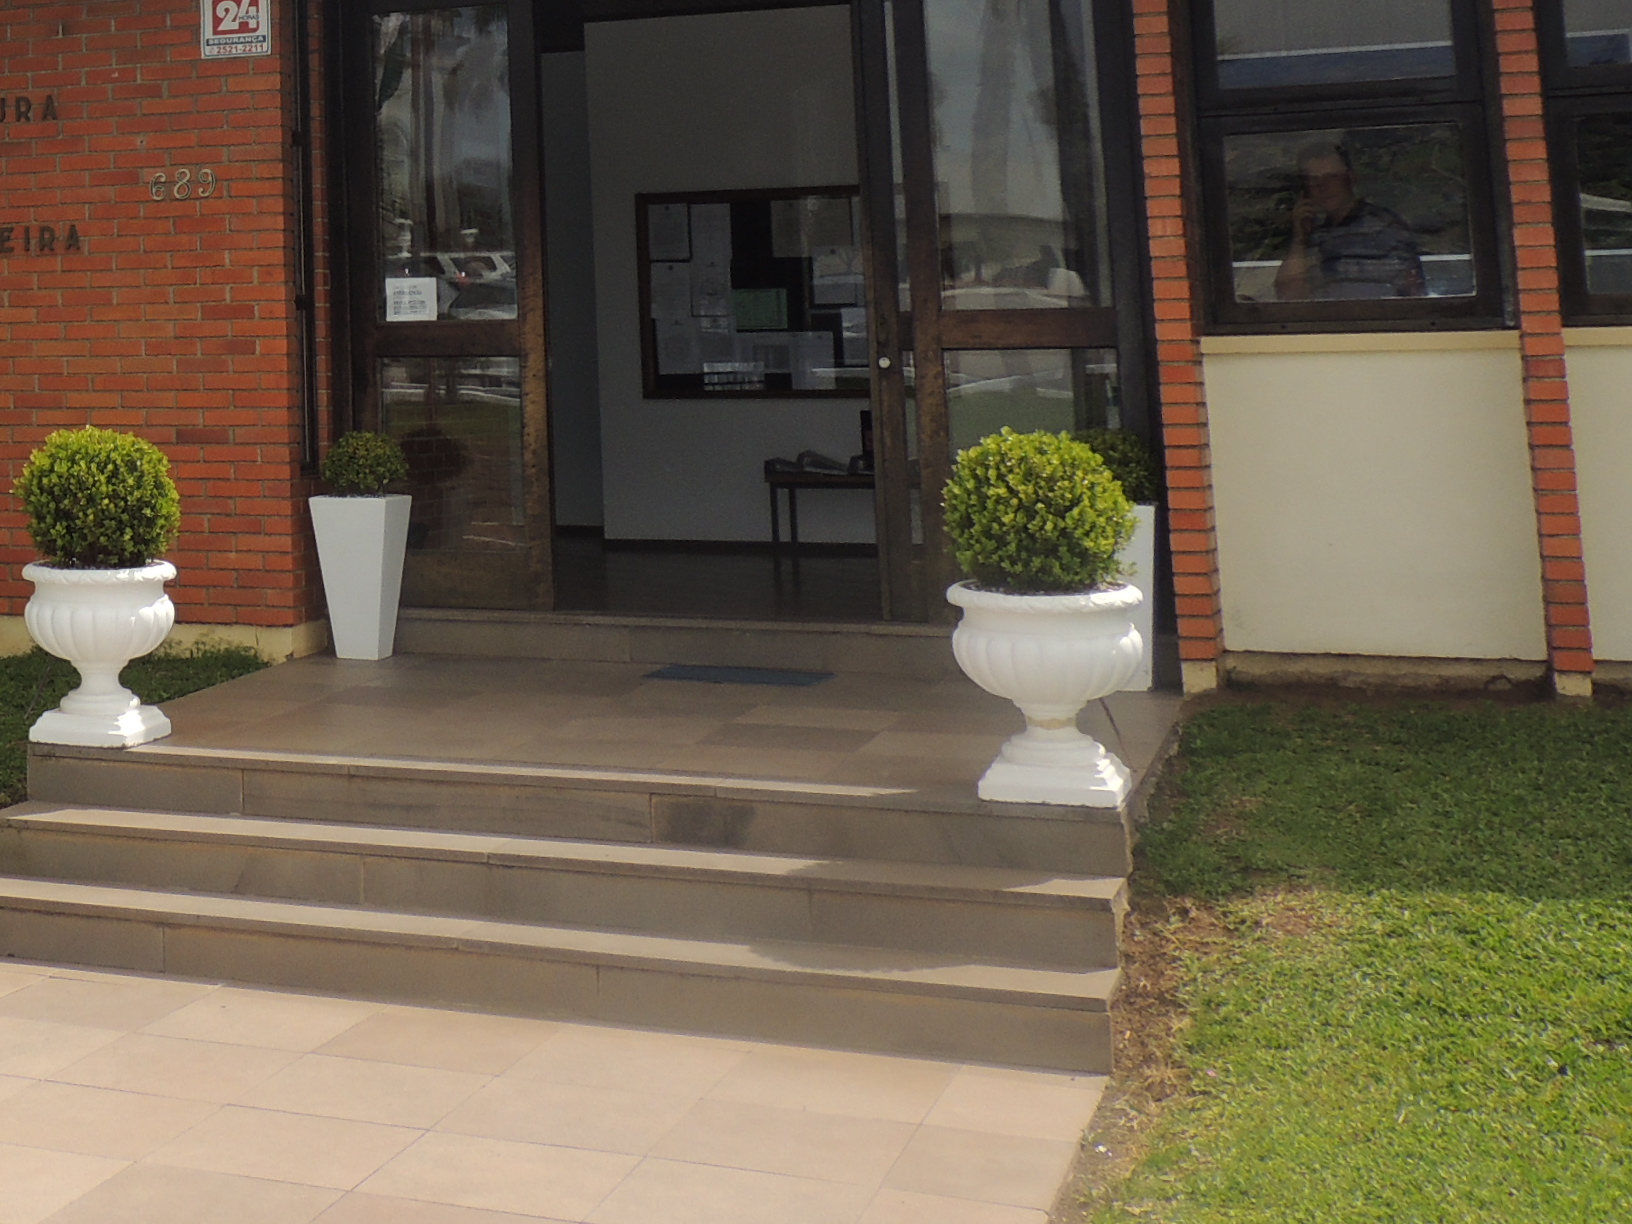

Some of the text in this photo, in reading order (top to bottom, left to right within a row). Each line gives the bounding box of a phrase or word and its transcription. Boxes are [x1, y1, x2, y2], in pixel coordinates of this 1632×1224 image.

[208, 36, 264, 45] SEGURANÇA
[216, 43, 264, 54] 2521-2211
[150, 168, 216, 201] 689
